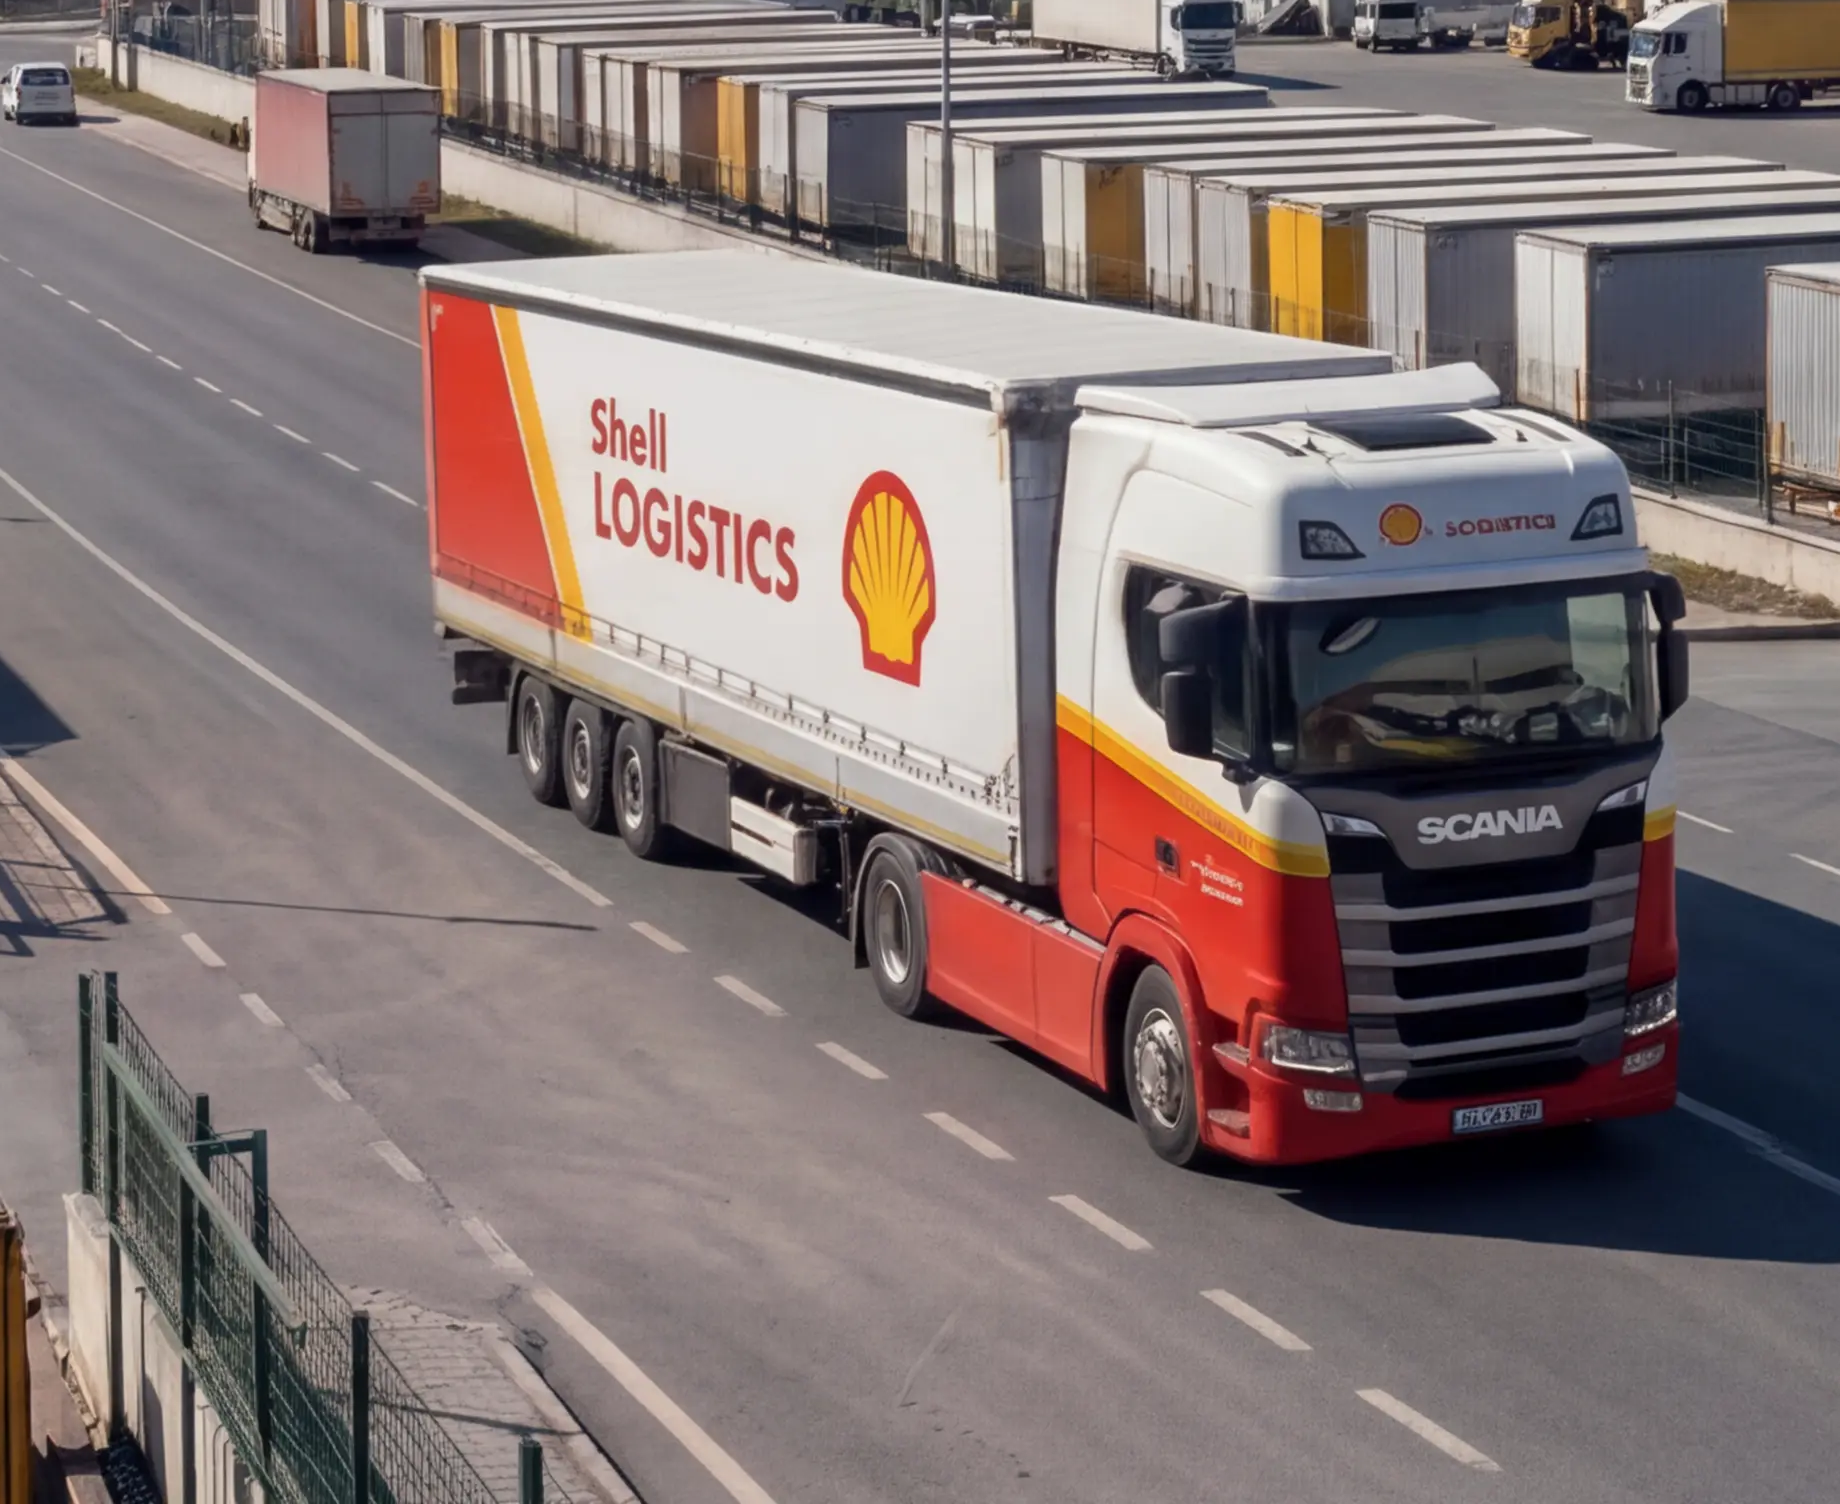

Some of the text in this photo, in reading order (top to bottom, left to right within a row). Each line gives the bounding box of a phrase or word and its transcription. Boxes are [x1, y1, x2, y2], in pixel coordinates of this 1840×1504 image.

[590, 397, 668, 473] Shell
[592, 473, 800, 603] LOGISTICS
[1417, 804, 1563, 845] SCANIA
